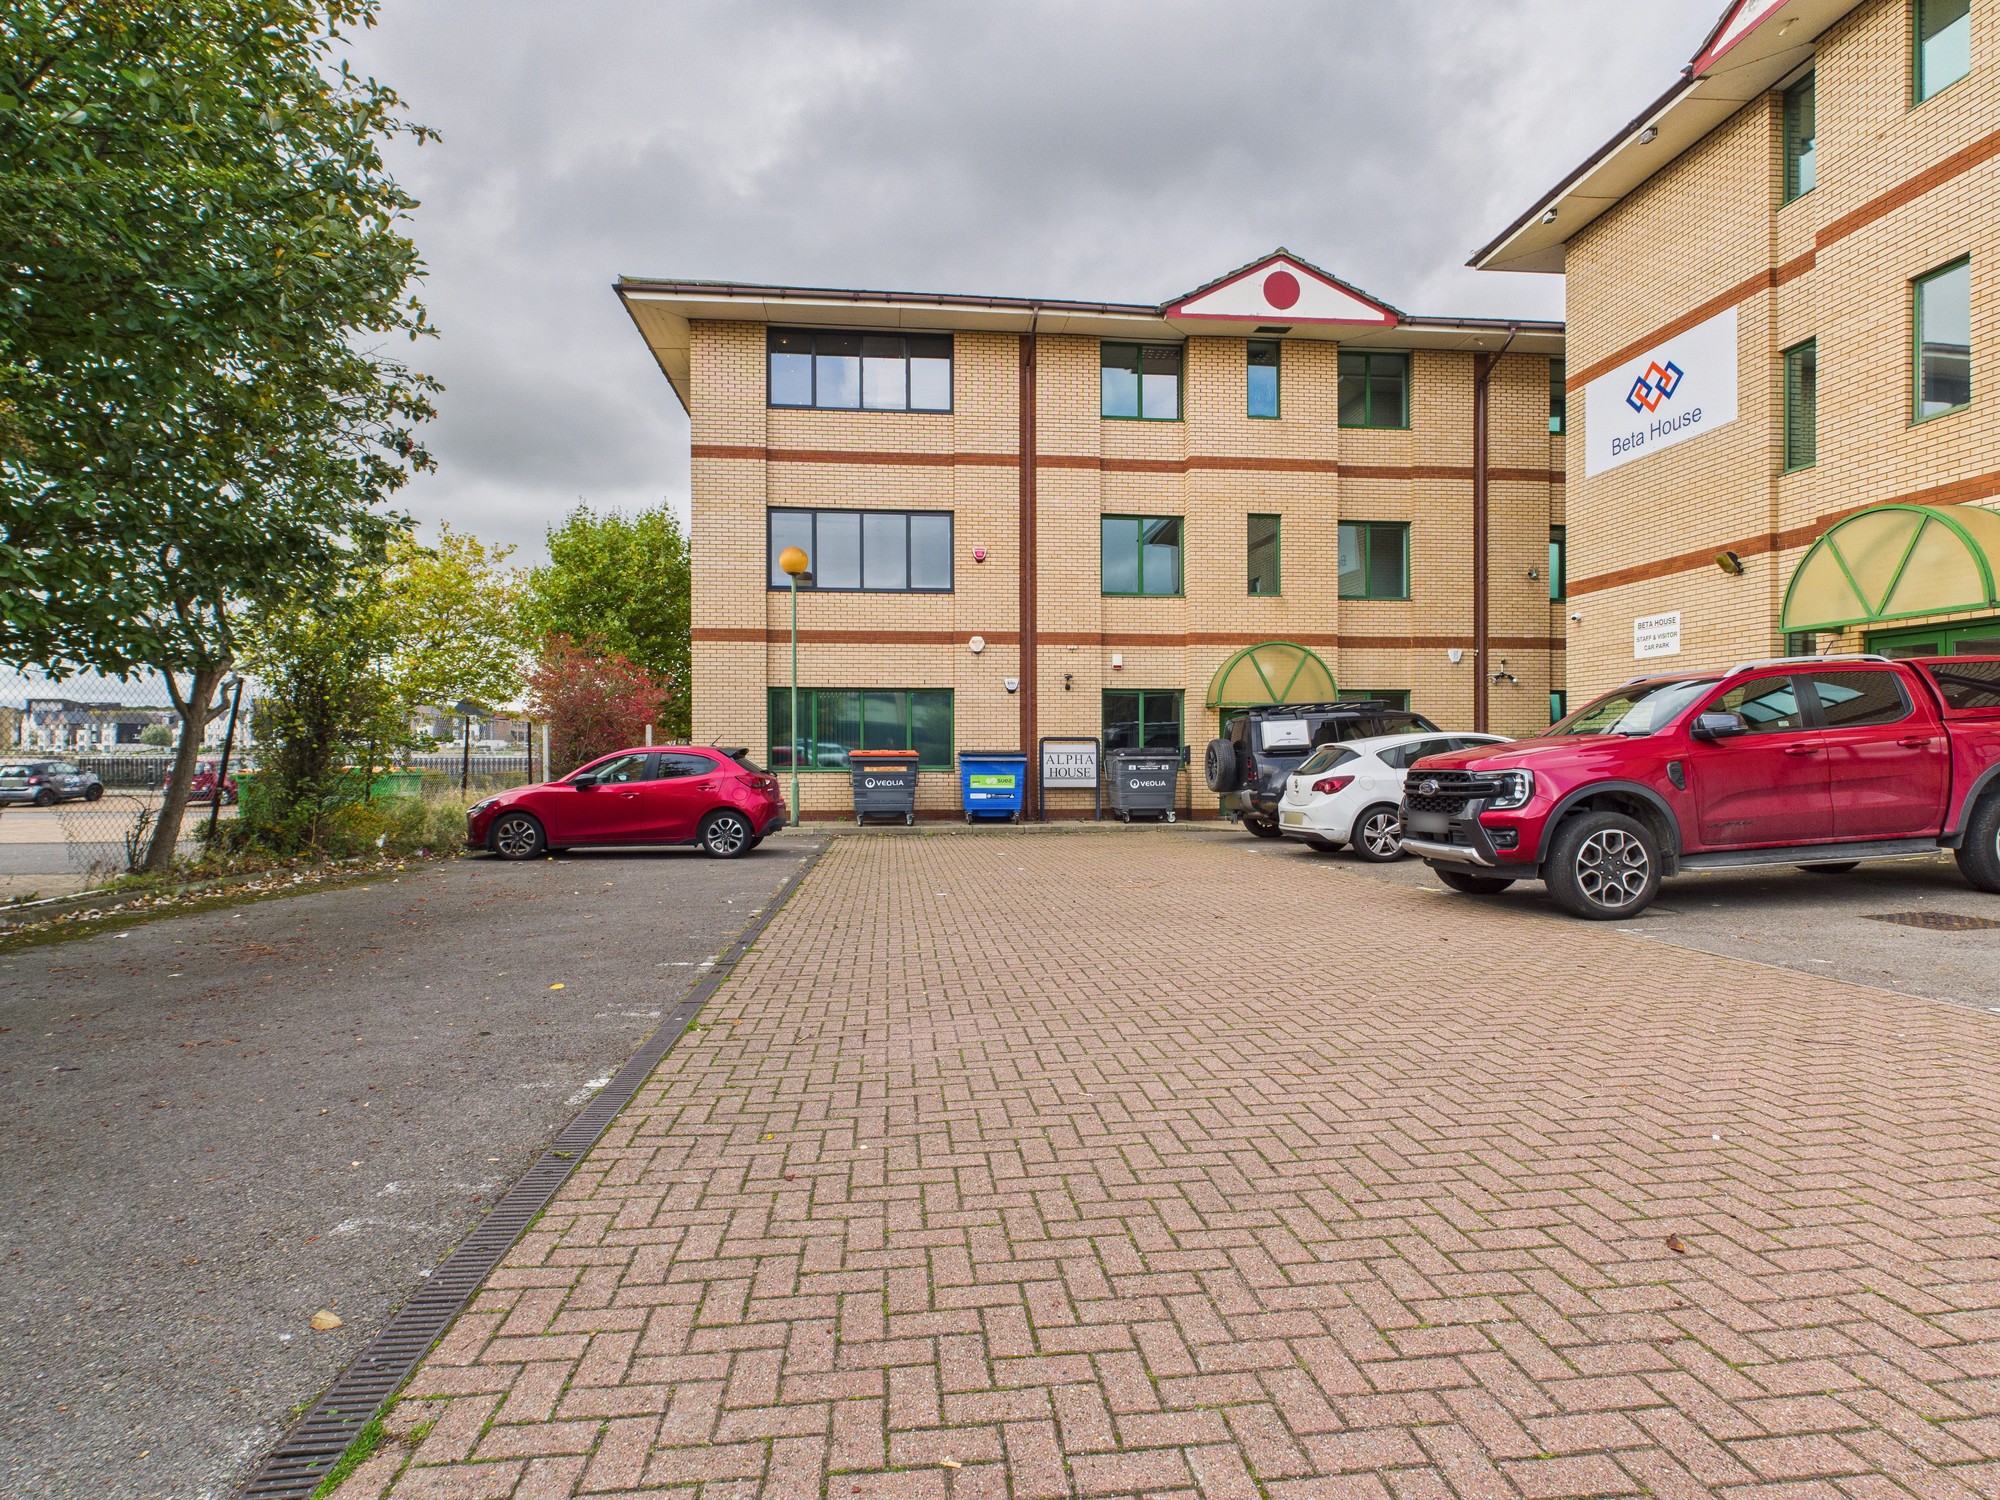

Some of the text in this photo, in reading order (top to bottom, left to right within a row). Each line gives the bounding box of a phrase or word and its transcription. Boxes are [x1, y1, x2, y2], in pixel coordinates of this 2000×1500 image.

[1612, 407, 1702, 456] Beta House
[1637, 617, 1676, 629] BETA HOUSE
[1636, 635, 1651, 643] STAFF
[1657, 631, 1677, 639] VISITOR
[1045, 754, 1094, 765] ALPHA
[1049, 767, 1092, 778] HOUSE
[876, 779, 904, 787] VEOLIA
